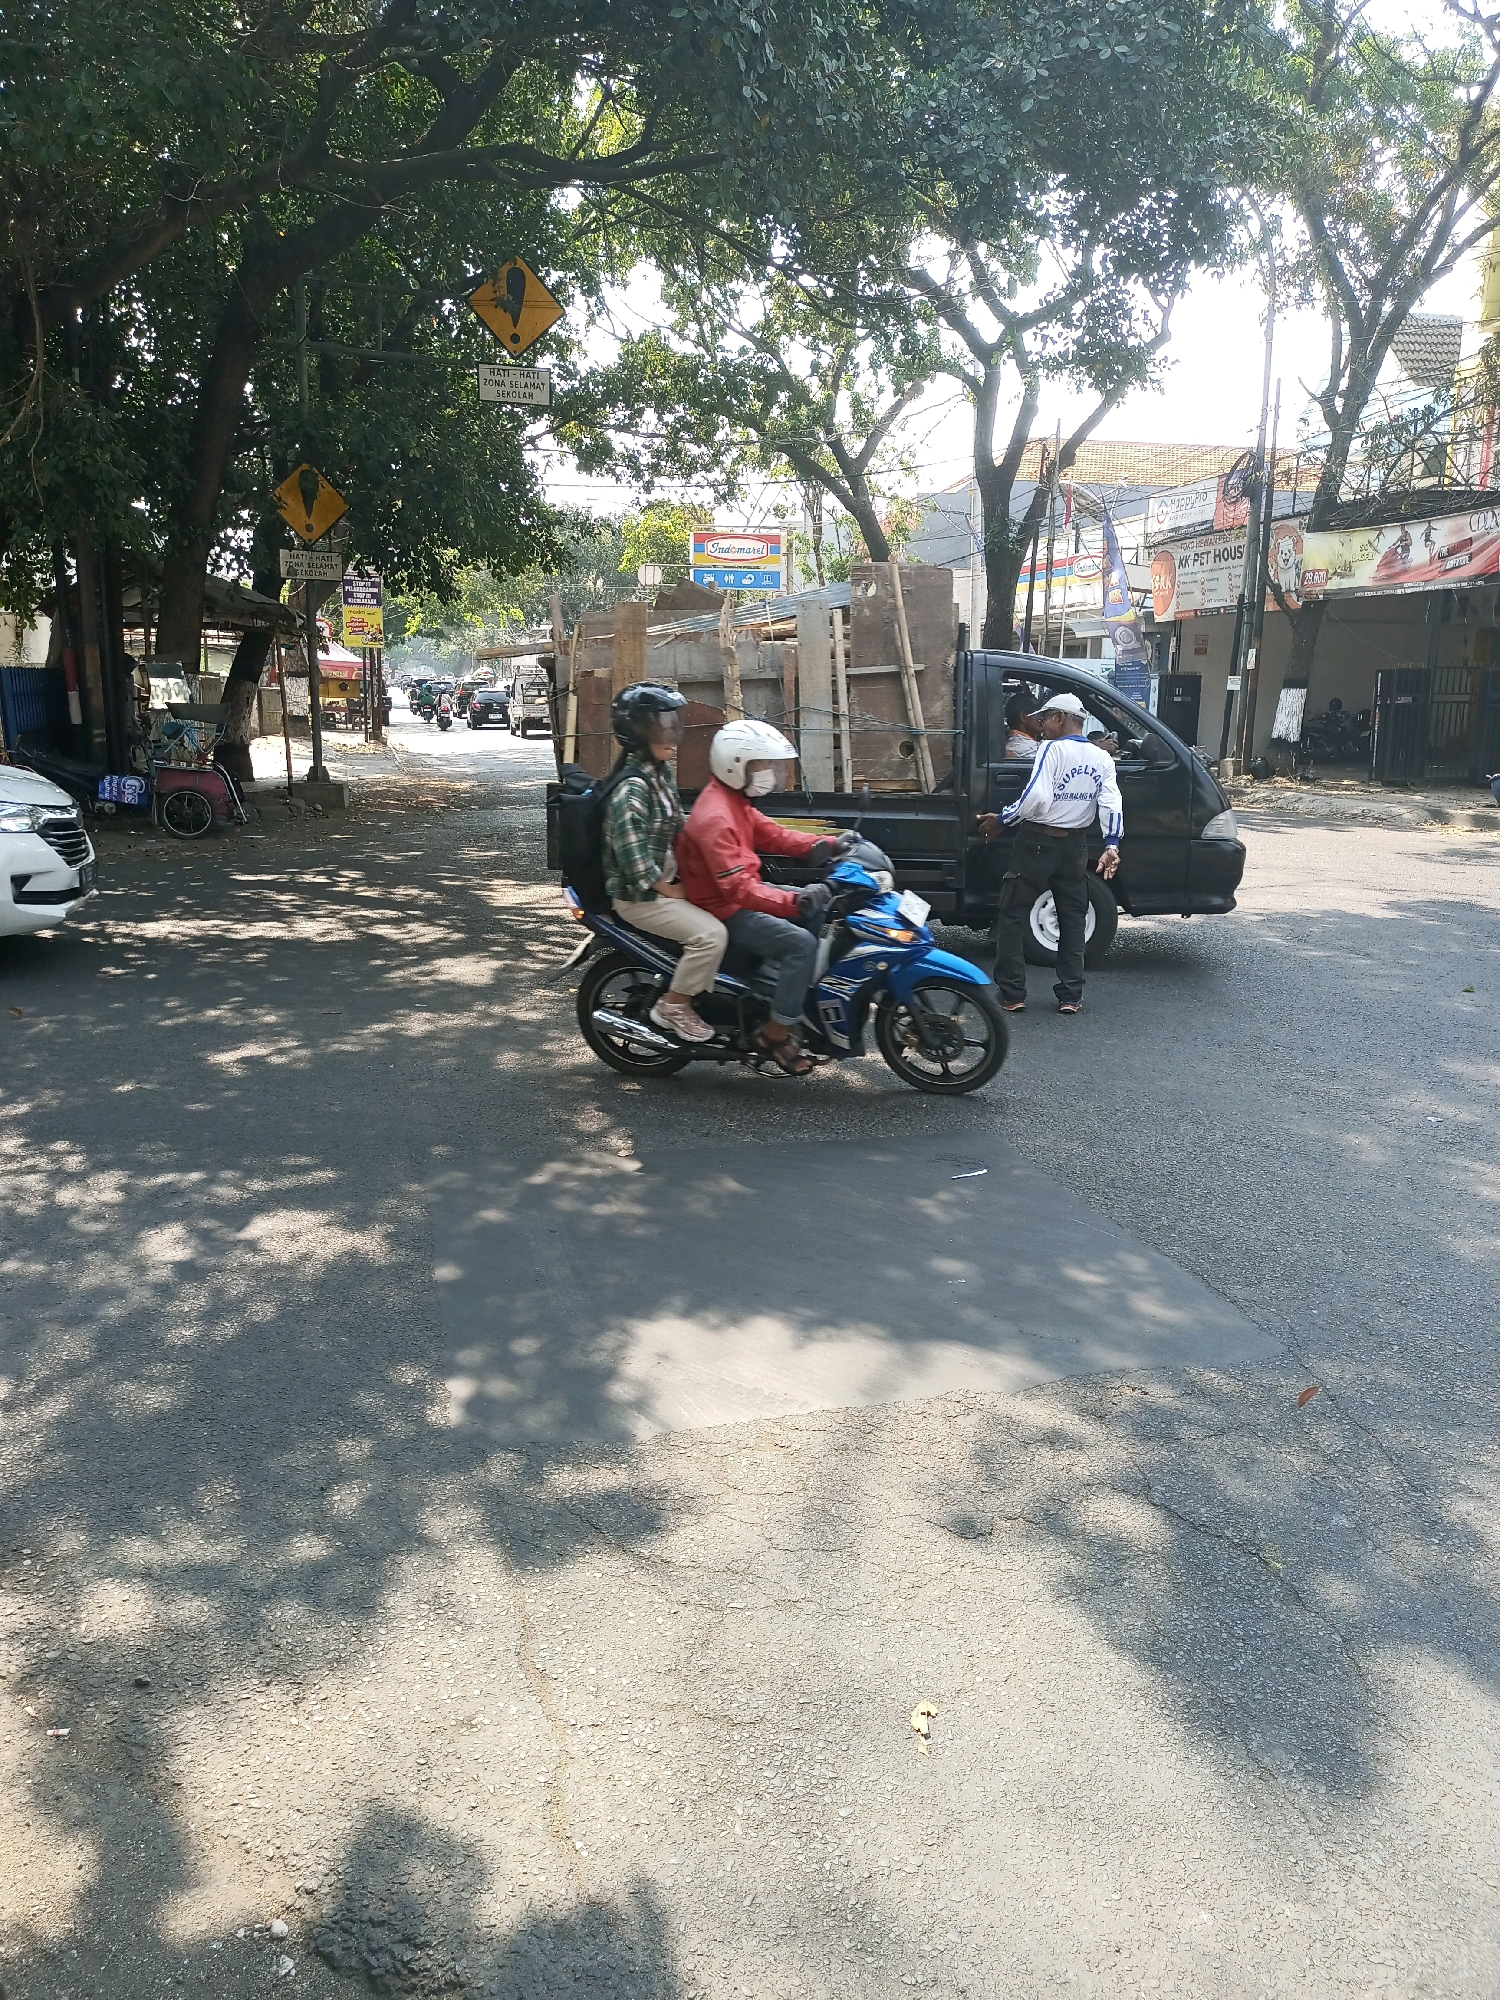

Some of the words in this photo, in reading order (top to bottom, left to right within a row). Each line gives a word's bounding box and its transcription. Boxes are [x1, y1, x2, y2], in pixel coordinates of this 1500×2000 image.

[489, 368, 510, 377] HATI
[519, 371, 540, 379] HATI
[483, 378, 506, 388] ZONA
[509, 380, 545, 392] SELAMAT
[496, 389, 534, 400] SEKOLAH
[709, 542, 765, 555] Indomaret
[284, 560, 304, 569] ZONA
[307, 562, 338, 570] SELAMAT
[1177, 553, 1191, 570] KK
[1192, 550, 1212, 567] PET
[296, 569, 328, 577] SEKOLAH
